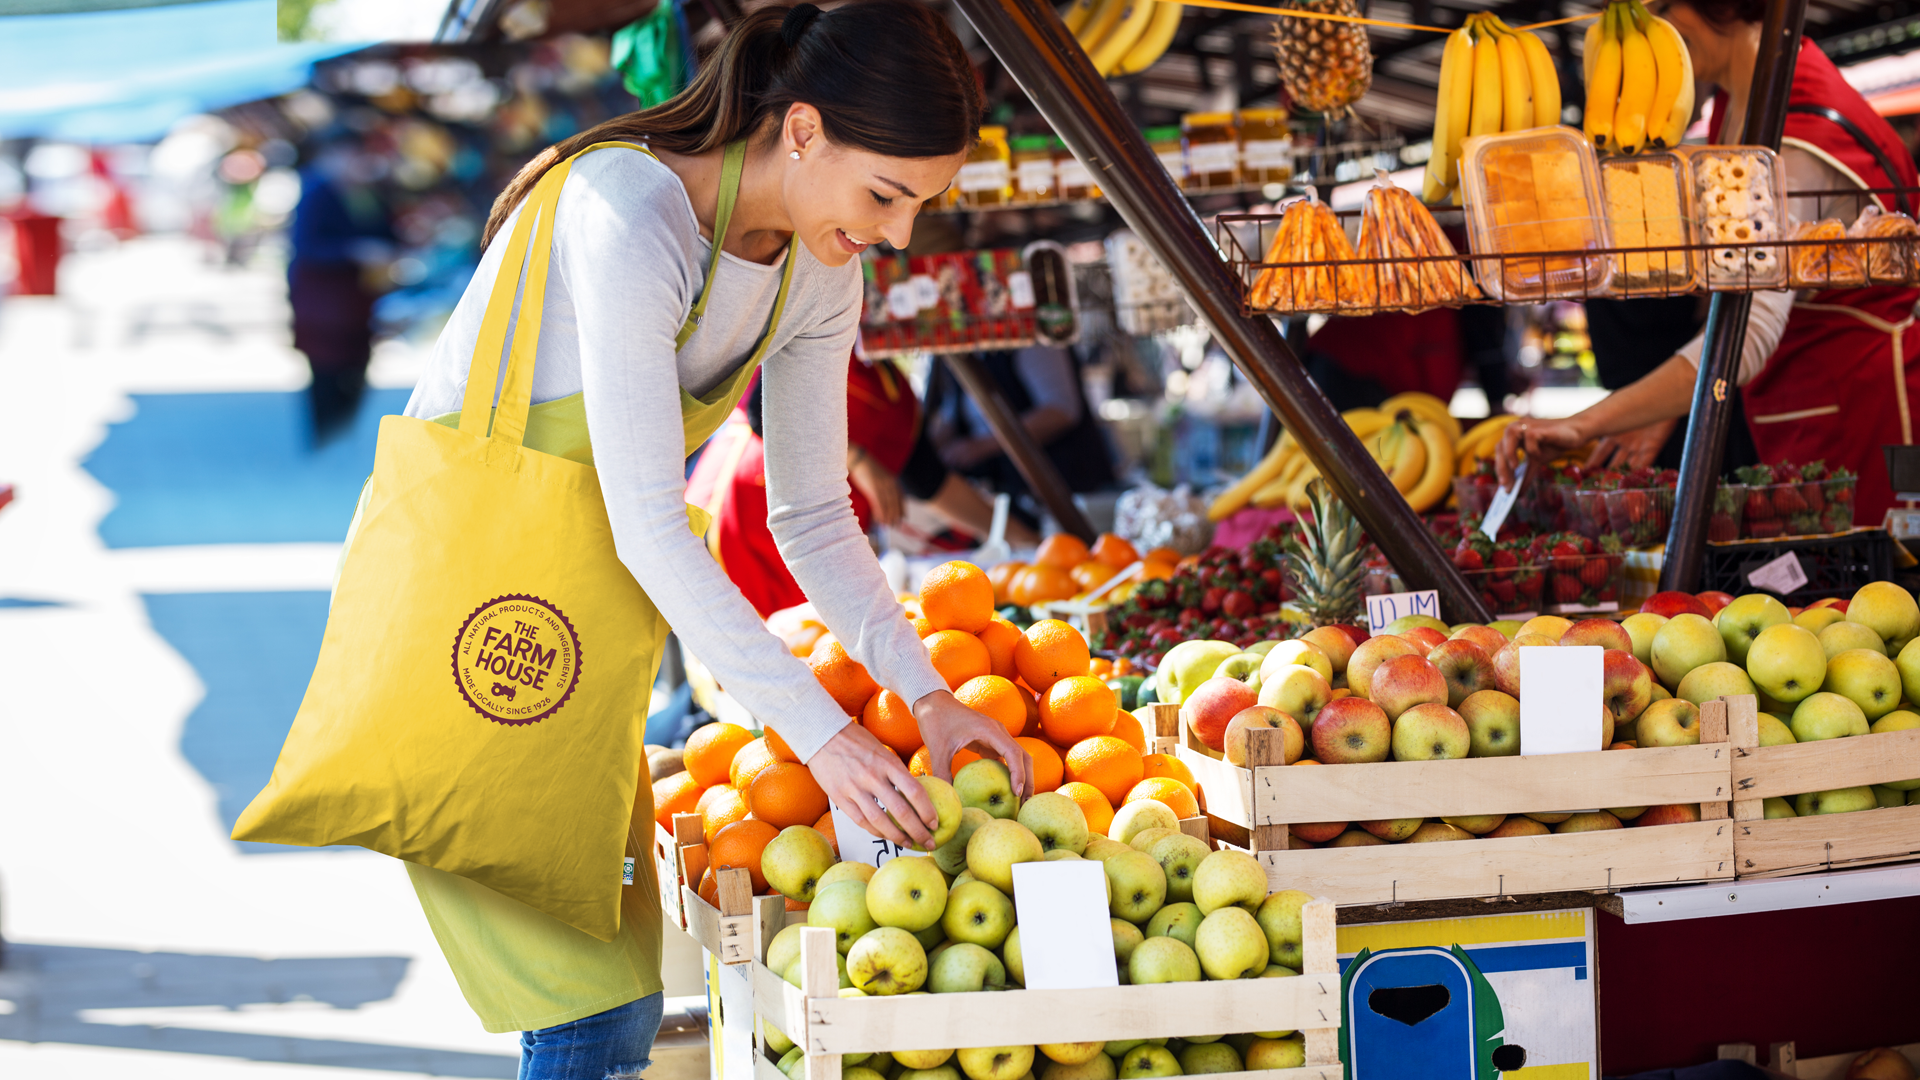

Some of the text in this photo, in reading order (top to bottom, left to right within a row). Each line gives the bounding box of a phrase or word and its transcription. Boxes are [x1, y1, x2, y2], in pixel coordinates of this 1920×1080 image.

[463, 605, 571, 689] ALL NATURAL PRODUCTS AND INGREDIENTS
[482, 626, 557, 670] FARM
[514, 620, 540, 640] THE
[463, 667, 551, 715] MADE LOCALLY SINCE 1926
[475, 648, 549, 691] HOUSE
